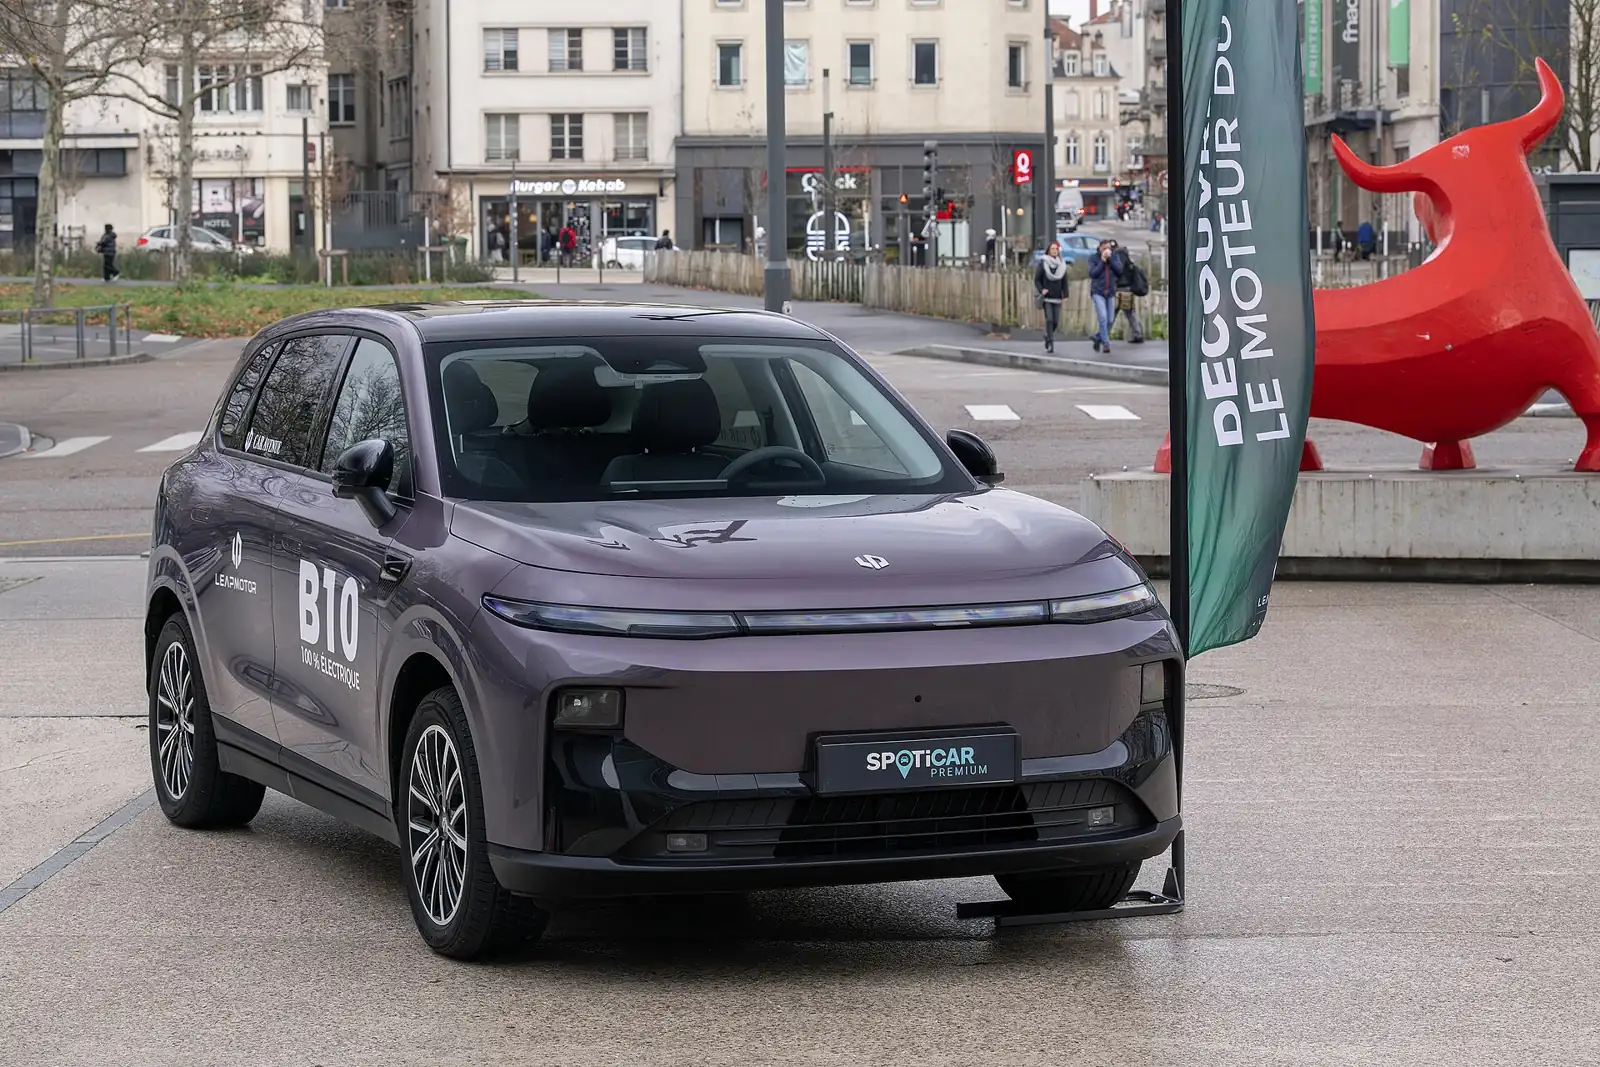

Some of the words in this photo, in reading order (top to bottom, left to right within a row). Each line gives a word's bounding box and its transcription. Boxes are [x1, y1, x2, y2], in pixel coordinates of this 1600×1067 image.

[1214, 15, 1235, 95] DU
[578, 179, 626, 192] Kebab
[1017, 153, 1030, 173] Q
[1215, 117, 1274, 360] MOTEUR
[1245, 378, 1290, 441] LE
[215, 573, 257, 594] LEAPMOTOR
[299, 559, 359, 662] B10
[301, 646, 313, 666] 100
[313, 654, 320, 670] %
[321, 652, 360, 691] ÉLECTRIQUE
[930, 764, 988, 778] PREMIUM
